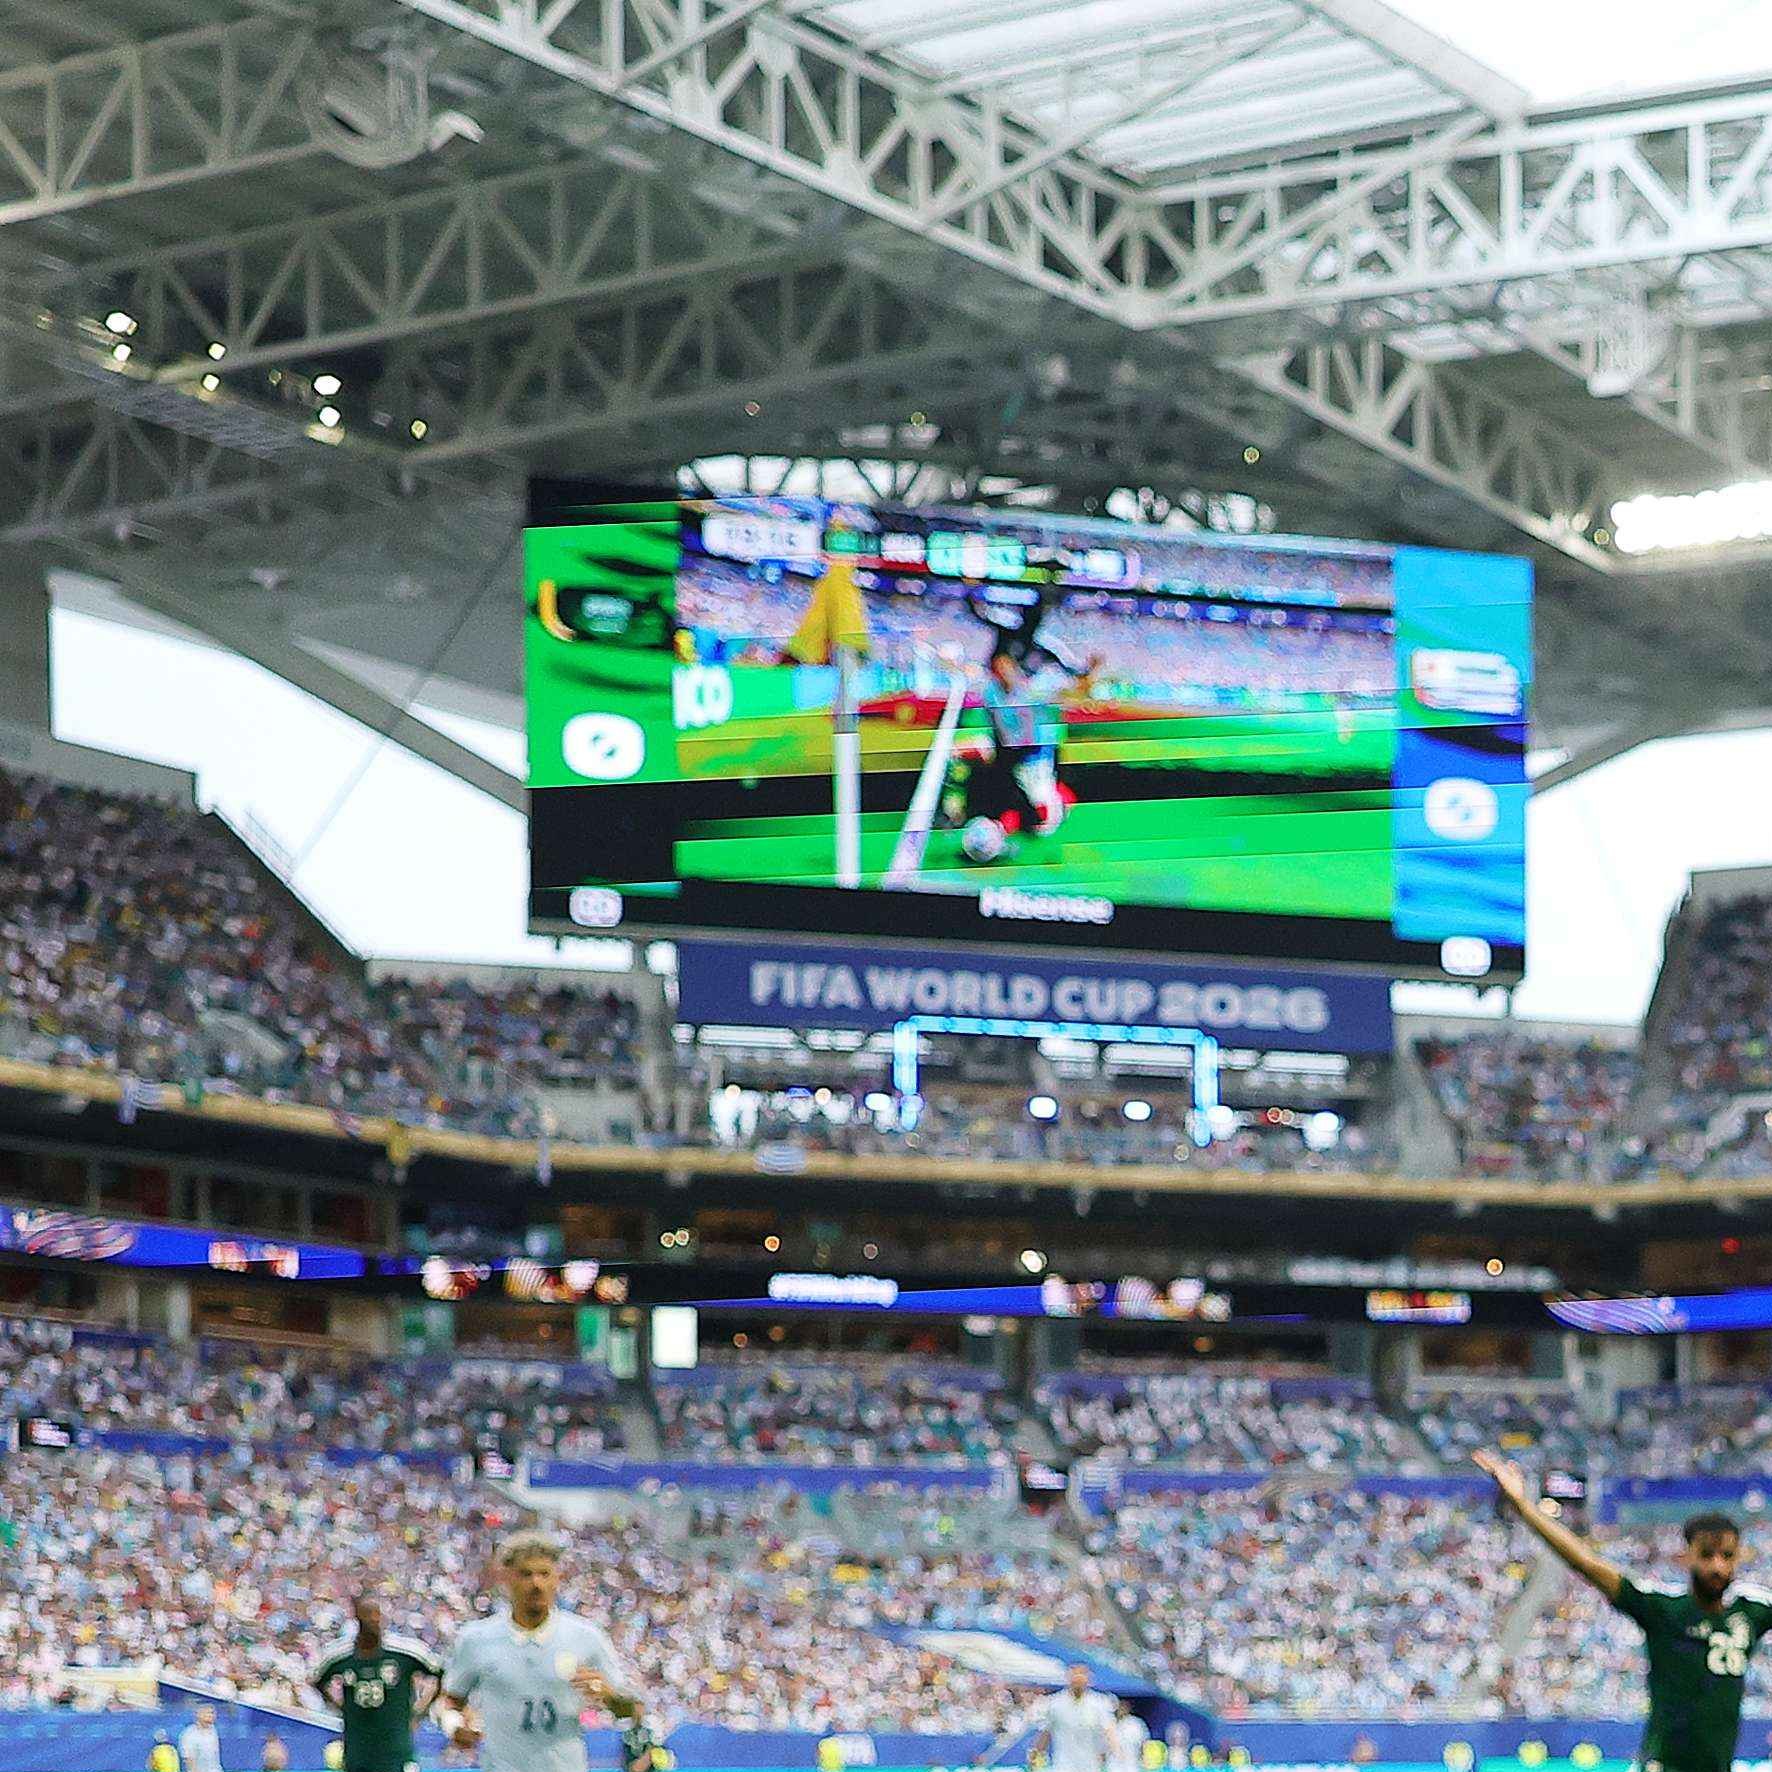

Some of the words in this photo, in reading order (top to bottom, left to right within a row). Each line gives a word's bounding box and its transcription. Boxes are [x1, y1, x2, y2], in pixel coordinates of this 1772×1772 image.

[748, 961, 862, 1011] FIFA
[862, 966, 1051, 1021] WORLD
[1051, 974, 1157, 1024] CUP
[1155, 980, 1333, 1035] 2026
